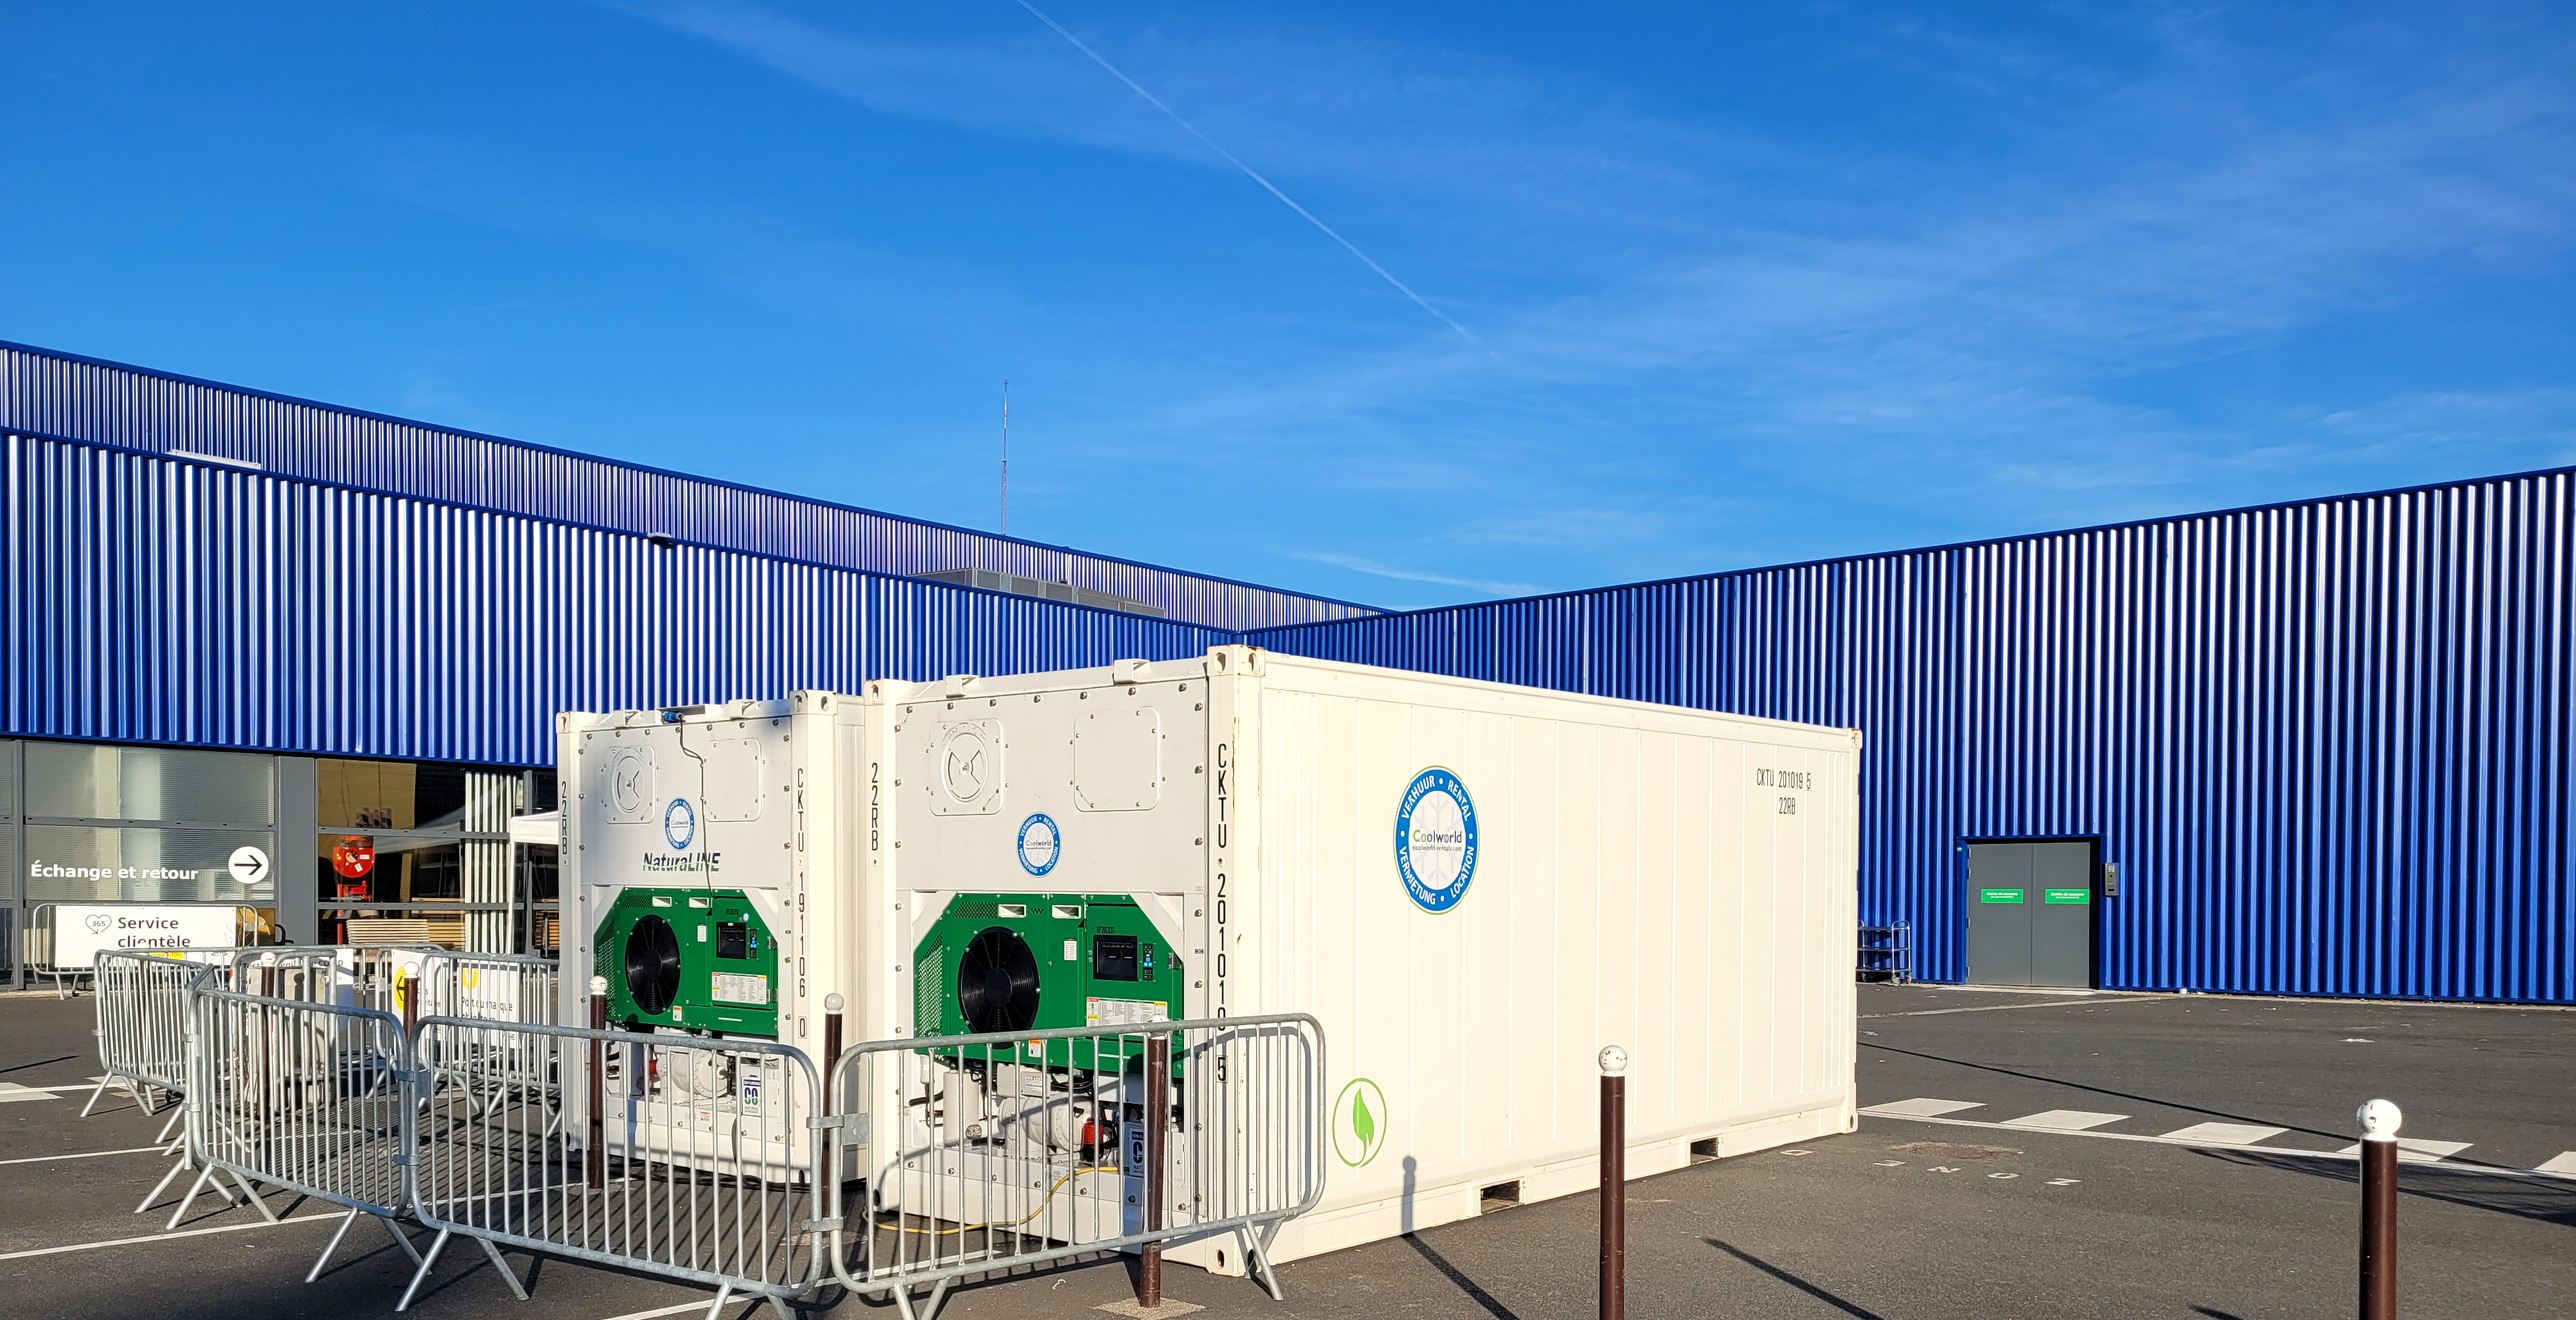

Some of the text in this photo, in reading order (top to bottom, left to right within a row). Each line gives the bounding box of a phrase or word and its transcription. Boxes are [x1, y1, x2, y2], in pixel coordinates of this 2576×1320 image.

[1756, 768, 1774, 787] CKTU
[1778, 770, 1803, 789] 201019
[871, 762, 879, 851] 22RB
[1217, 743, 1227, 848] CKTU
[1401, 775, 1472, 822] VERHUUR RENTAL
[1778, 796, 1796, 815] 22RB
[797, 768, 805, 852] CKTU
[1412, 829, 1462, 843] Coolworld
[30, 859, 199, 882] Échange et retour
[643, 852, 721, 871] NaturaLINE
[1399, 846, 1475, 905] VERMIETUNG LOCATION
[117, 916, 179, 929] Service
[798, 871, 806, 998] 191106
[1217, 1056, 1227, 1081] 5
